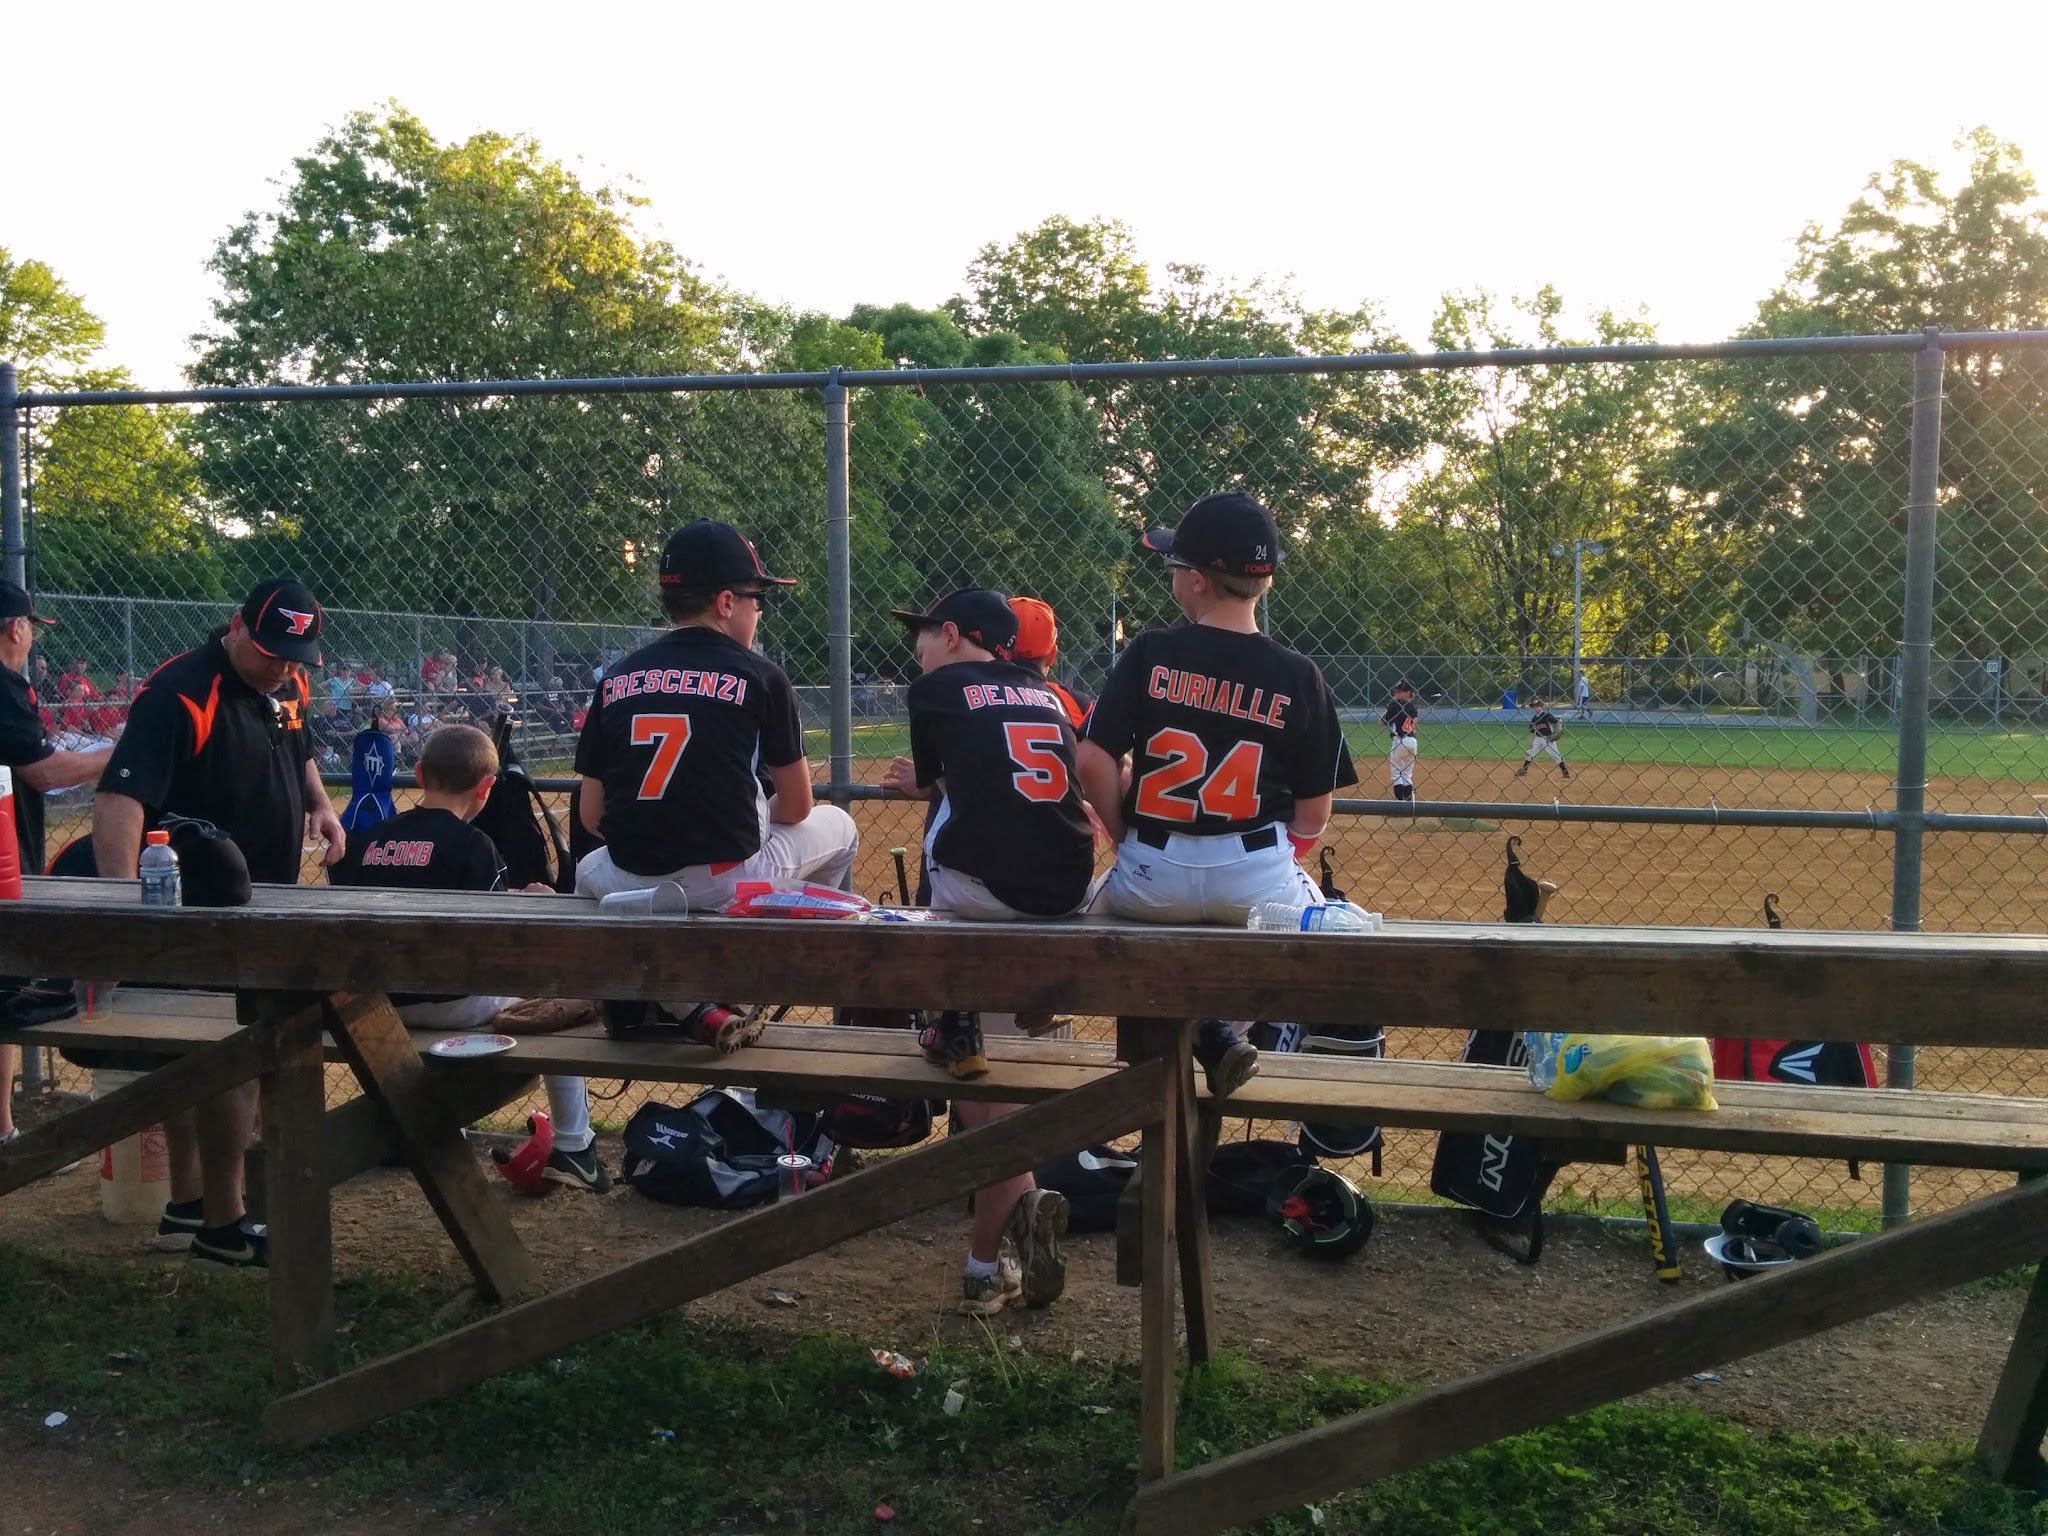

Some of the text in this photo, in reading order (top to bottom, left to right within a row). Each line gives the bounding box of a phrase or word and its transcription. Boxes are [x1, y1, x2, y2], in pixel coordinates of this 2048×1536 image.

[660, 574, 681, 583] ORGE
[666, 555, 670, 568] 7
[1255, 545, 1267, 560] 24
[602, 669, 747, 708] CRESCENZI
[1148, 665, 1291, 729] CURIALLE
[630, 713, 692, 800] 7
[1003, 722, 1069, 803] 5
[1135, 727, 1263, 823] 24
[1637, 1144, 1666, 1262] EASTON
